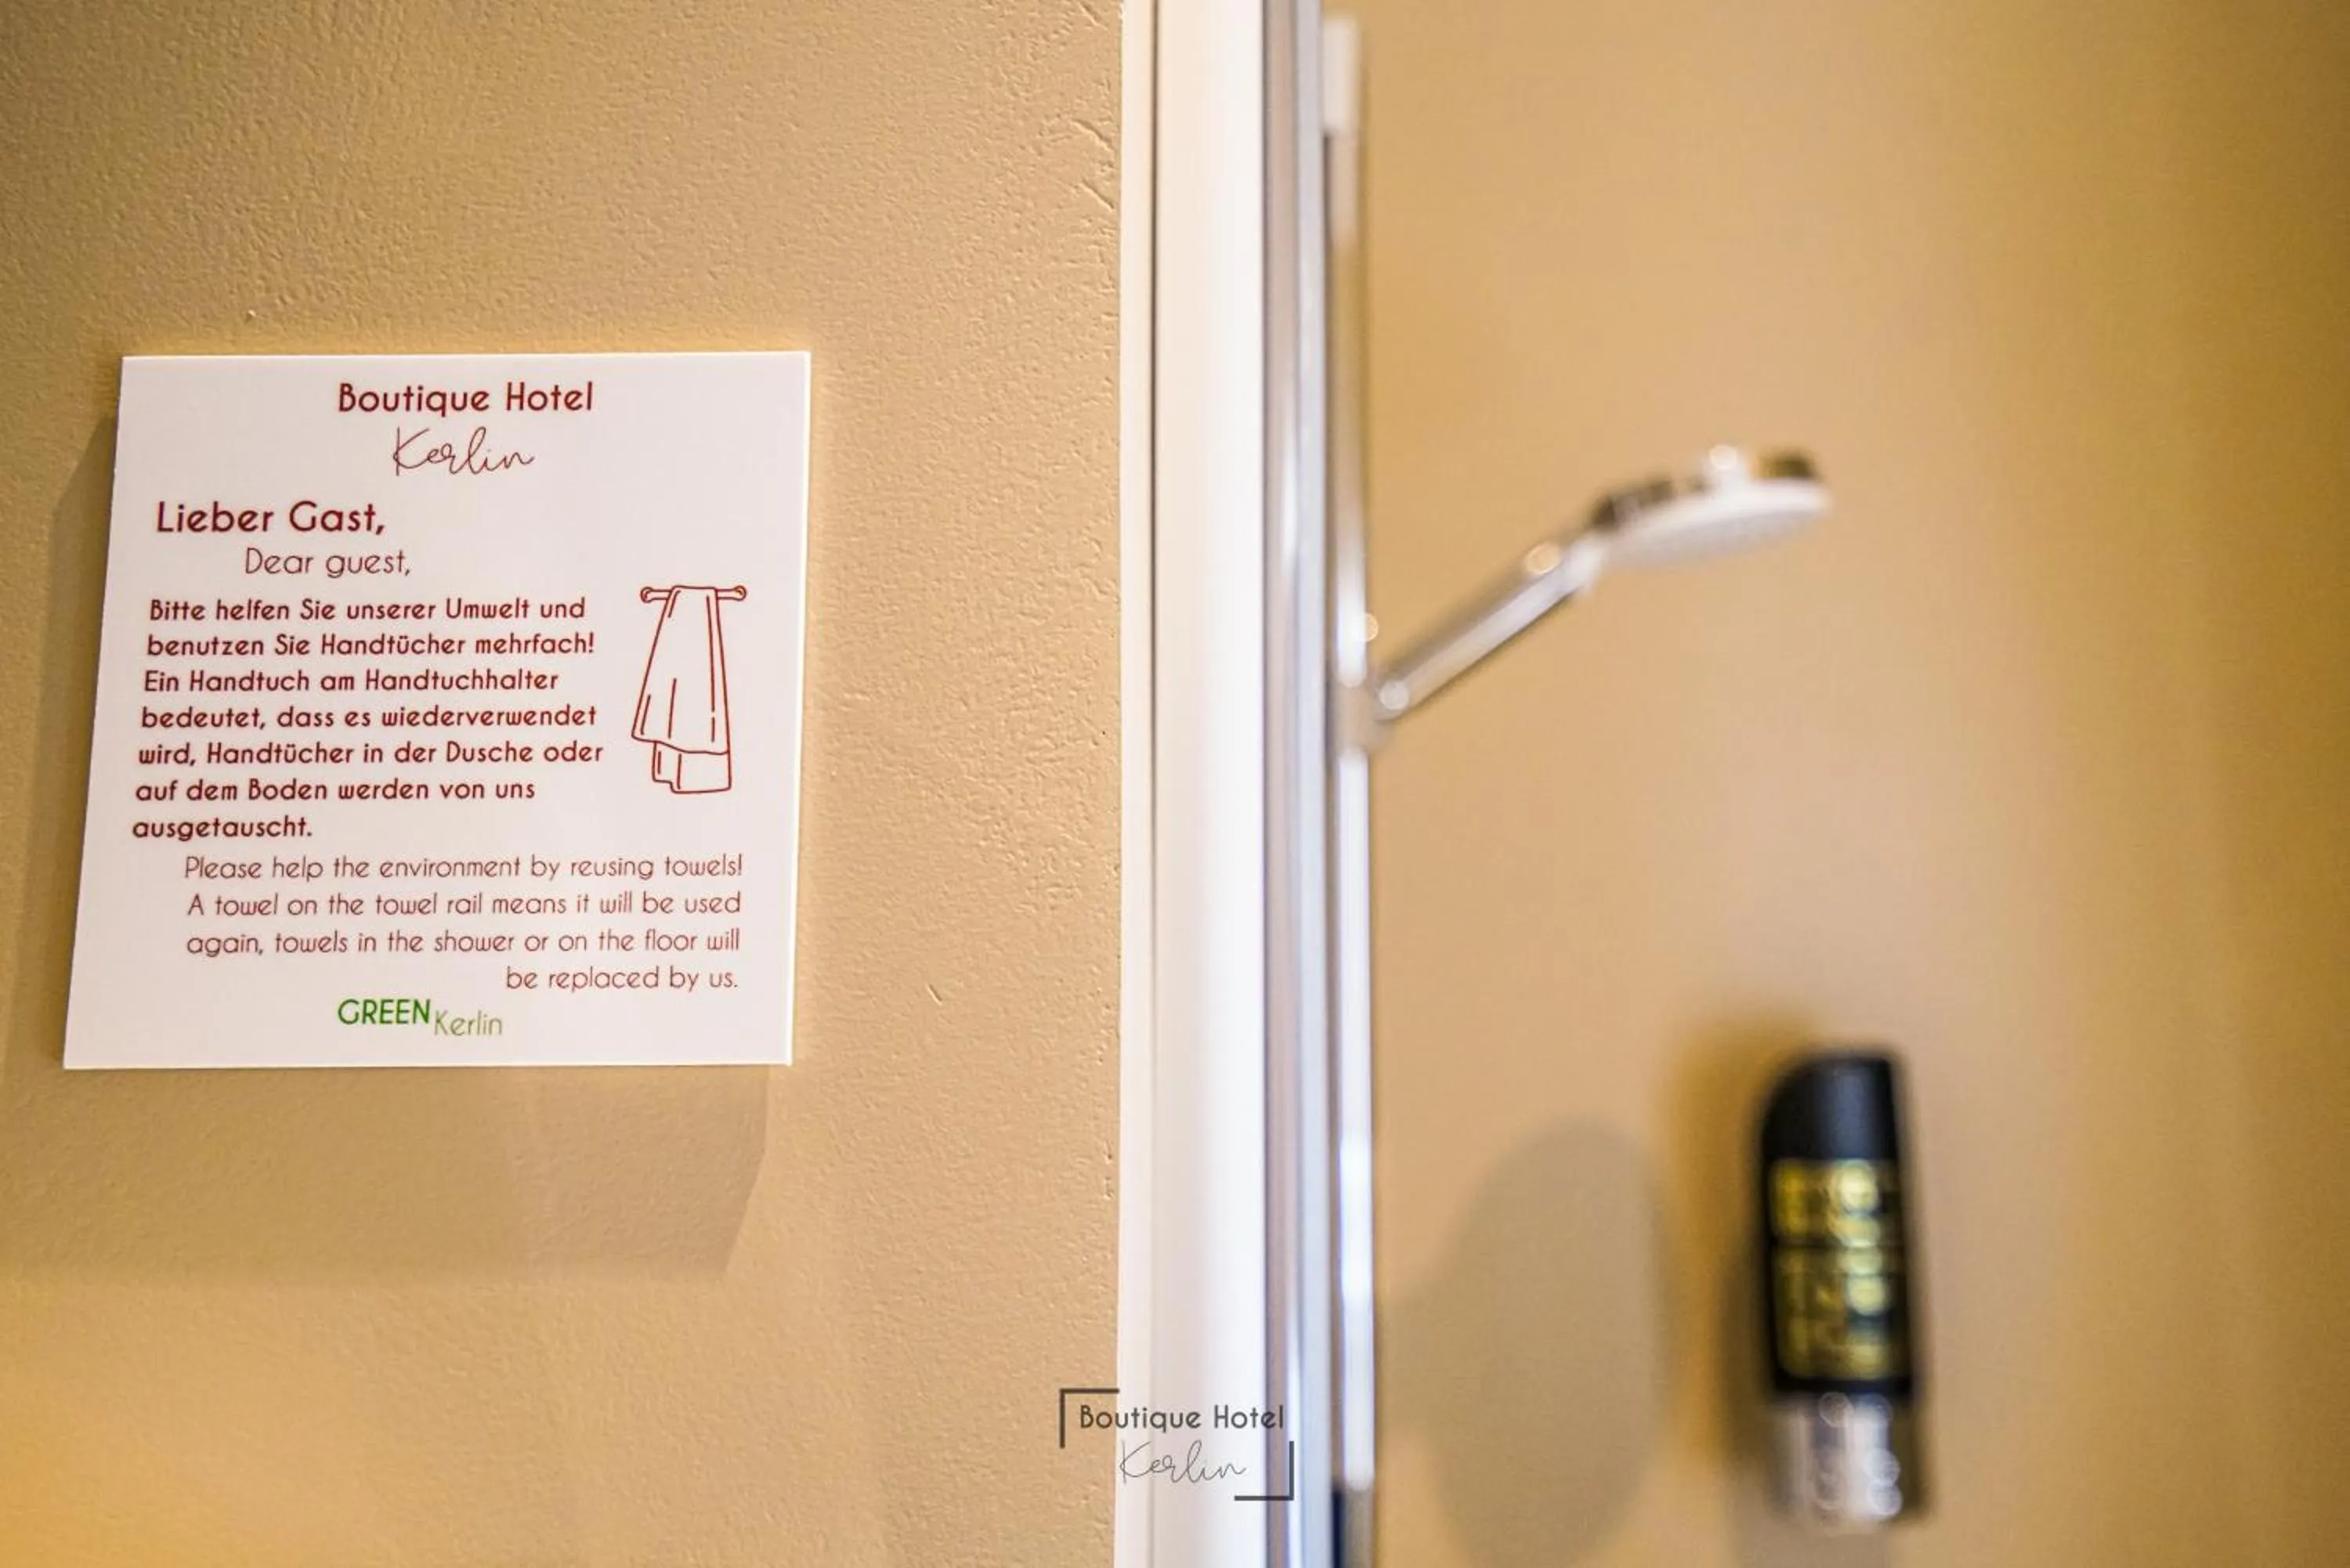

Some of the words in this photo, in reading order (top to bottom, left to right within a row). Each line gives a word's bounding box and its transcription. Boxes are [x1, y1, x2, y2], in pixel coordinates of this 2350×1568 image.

[338, 382, 490, 417] Boutique
[505, 381, 593, 411] Hotel
[392, 426, 534, 476] Kerlin
[157, 500, 274, 533] Lieber
[288, 500, 385, 536] Gast,
[245, 547, 313, 574] Dear
[326, 550, 410, 579] guest,
[150, 598, 205, 621] Bitte
[215, 598, 290, 620] helfen
[300, 598, 335, 620] Sie
[347, 603, 436, 620] unserer
[446, 597, 530, 619] Umwelt
[540, 596, 585, 619] und
[146, 634, 264, 656] benutzen
[274, 634, 310, 656] Sie
[321, 633, 466, 656] Handtücher
[475, 631, 594, 654] mehrfach!
[144, 670, 179, 692] Ein
[190, 669, 309, 692] Handtuch
[320, 675, 355, 692] am
[366, 668, 559, 691] Handtuchhalter
[141, 706, 266, 730] bedeutet,
[277, 705, 334, 728] dass
[344, 711, 371, 727] es
[381, 703, 597, 727] wiederverwendet
[139, 742, 196, 766] wird,
[207, 741, 354, 764] Handtücher
[363, 743, 383, 763] in
[394, 741, 436, 764] der
[446, 740, 533, 763] Dusche
[543, 740, 604, 762] oder
[136, 779, 179, 801] auf
[186, 779, 237, 801] dem
[248, 778, 327, 800] Boden
[338, 777, 428, 800] werden
[439, 783, 485, 800] von
[495, 783, 535, 799] uns
[132, 815, 313, 842] ausgetauscht.
[185, 856, 262, 879] Please
[273, 855, 323, 882] help
[334, 855, 370, 877] the
[379, 857, 520, 877] environment
[531, 854, 560, 880] by
[571, 858, 654, 880] reusing
[664, 853, 742, 876] towels!
[188, 894, 204, 916] A
[215, 893, 278, 916] towel
[287, 899, 317, 916] on
[329, 893, 363, 915] the
[376, 892, 437, 915] towel
[447, 893, 482, 915] rail
[493, 898, 566, 914] means
[577, 894, 589, 912] it
[600, 891, 632, 914] will
[642, 891, 674, 914] be
[685, 891, 741, 913] used
[186, 934, 263, 958] again,
[276, 930, 348, 953] towels
[358, 933, 376, 952] in
[388, 930, 423, 952] the
[434, 930, 514, 952] shower
[525, 935, 548, 952] or
[559, 935, 587, 952] on
[598, 929, 634, 951] the
[645, 928, 697, 951] floor
[707, 927, 739, 950] will
[507, 966, 537, 989] be
[549, 965, 660, 992] replaced
[670, 965, 700, 992] by
[710, 973, 738, 988] us.
[337, 999, 431, 1025] GREEN
[435, 1010, 502, 1036] Kerlin
